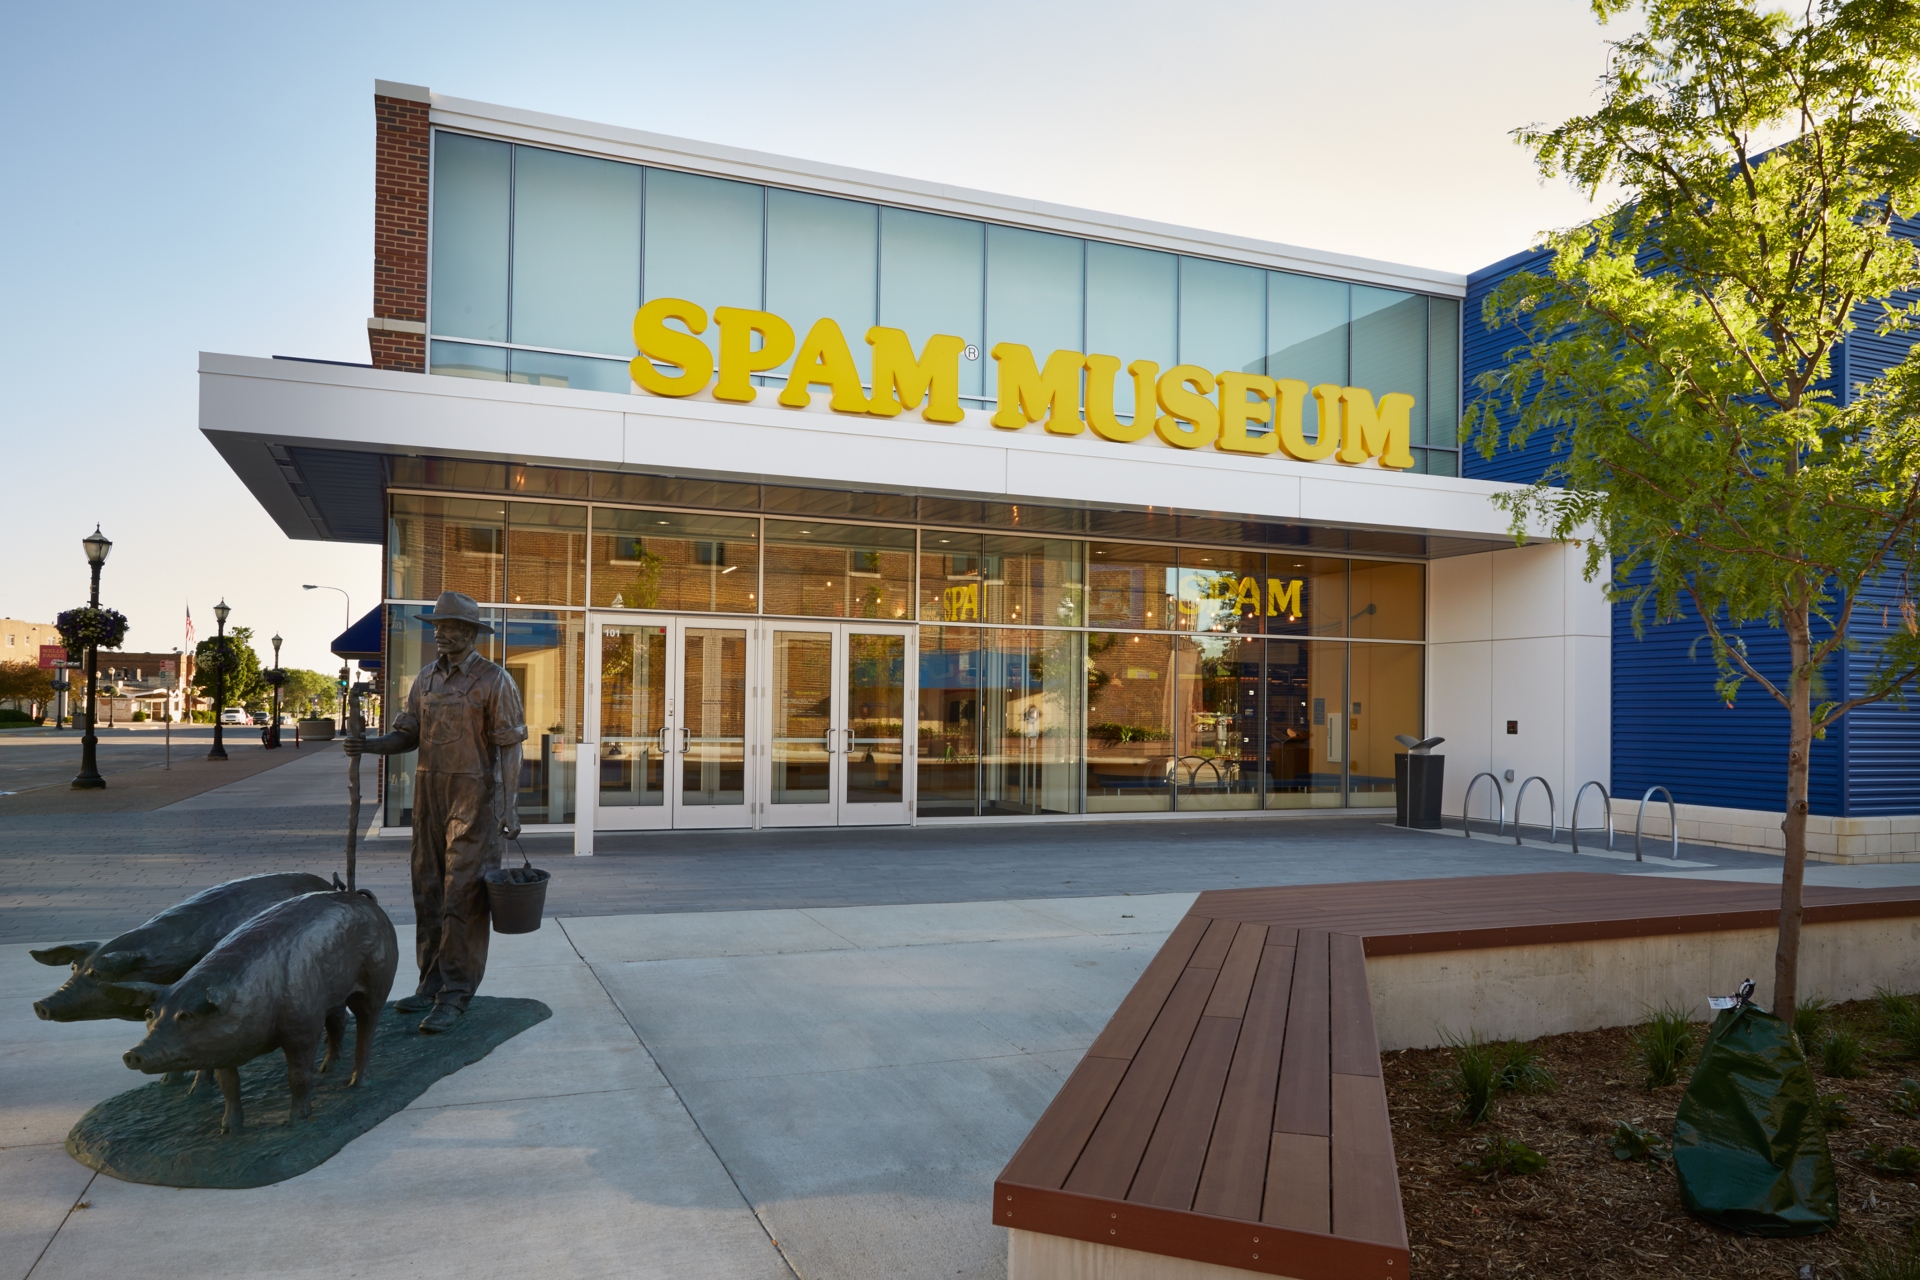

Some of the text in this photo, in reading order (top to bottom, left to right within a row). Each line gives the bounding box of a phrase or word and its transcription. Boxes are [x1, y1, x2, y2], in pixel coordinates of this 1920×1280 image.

[989, 341, 1416, 470] MUSEUM
[1178, 575, 1304, 618] SPAM
[604, 629, 621, 637] 101
